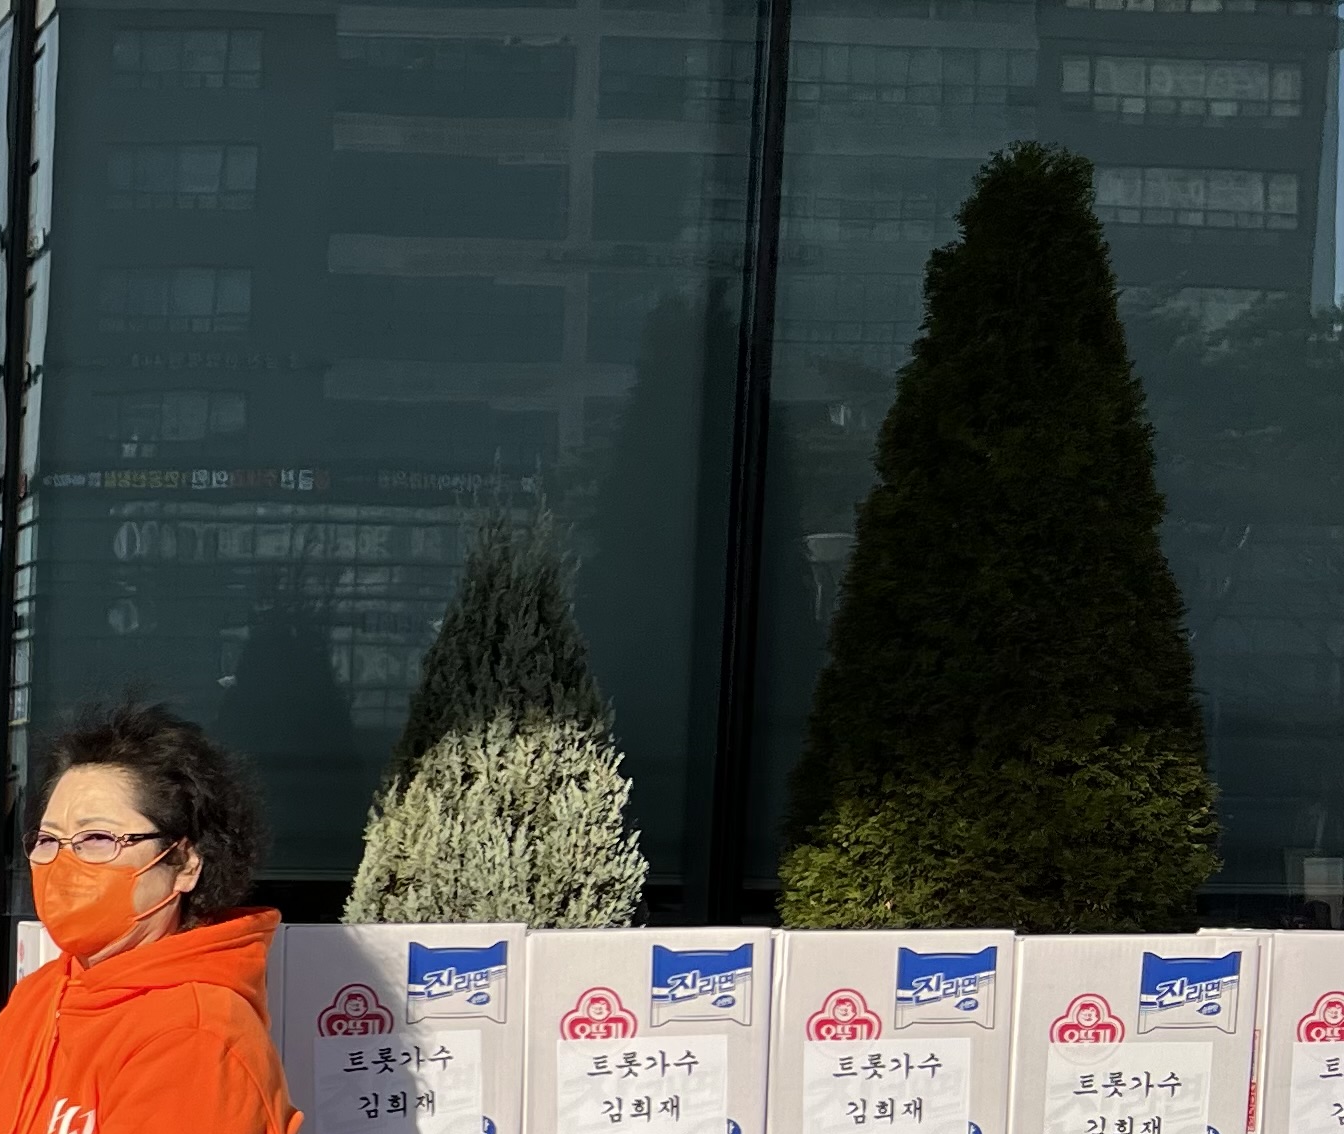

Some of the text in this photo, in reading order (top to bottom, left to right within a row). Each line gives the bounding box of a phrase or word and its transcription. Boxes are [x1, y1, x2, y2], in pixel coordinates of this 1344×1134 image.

[422, 966, 492, 998] 진라면
[667, 970, 736, 1001] 진라면
[912, 973, 980, 1004] 진라면
[1155, 977, 1222, 1008] 진라면
[343, 1045, 453, 1075] 트롯가수
[587, 1050, 699, 1079] 트롯가수
[832, 1052, 942, 1080] 트롯가수
[1073, 1071, 1182, 1098] 트롯가수
[358, 1089, 435, 1119] 김희재
[603, 1094, 680, 1123] 김희재
[847, 1097, 923, 1125] 김희재
